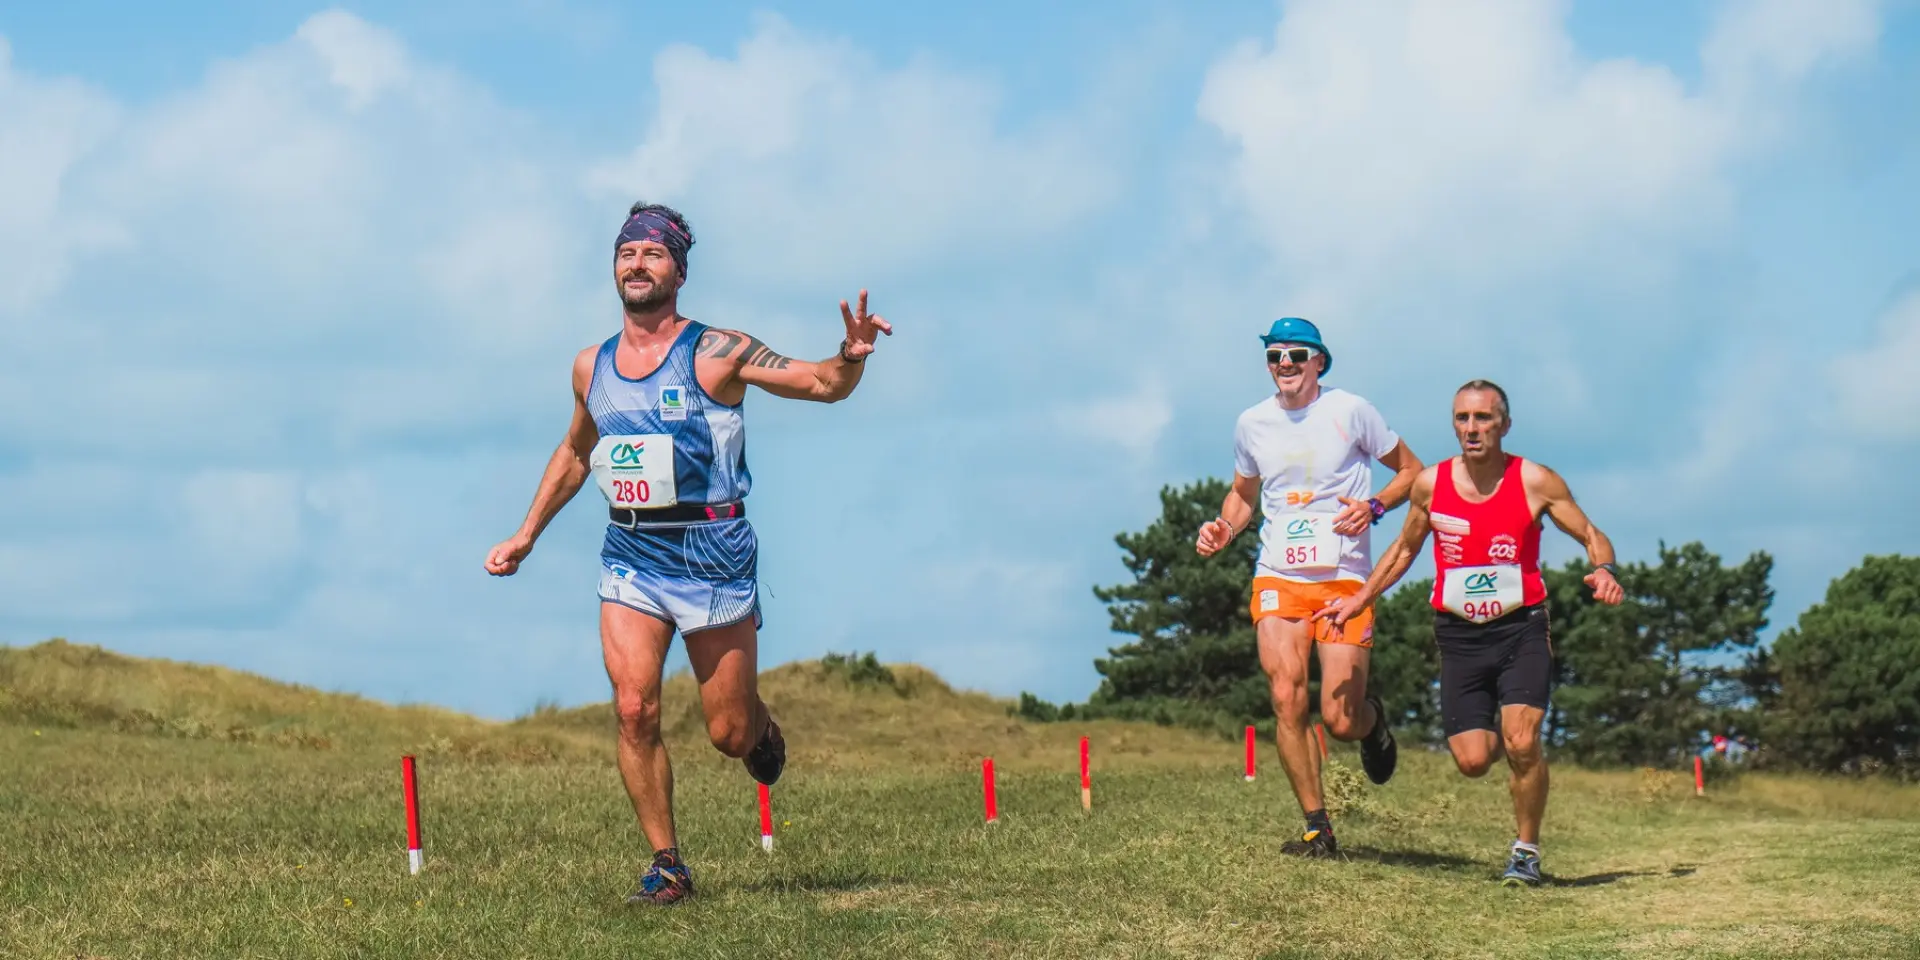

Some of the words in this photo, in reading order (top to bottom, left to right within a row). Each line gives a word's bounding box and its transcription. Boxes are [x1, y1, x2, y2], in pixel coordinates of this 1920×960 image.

[612, 480, 650, 504] 280
[1285, 545, 1317, 565] 851
[1487, 543, 1517, 559] COS
[1463, 600, 1503, 620] 940
